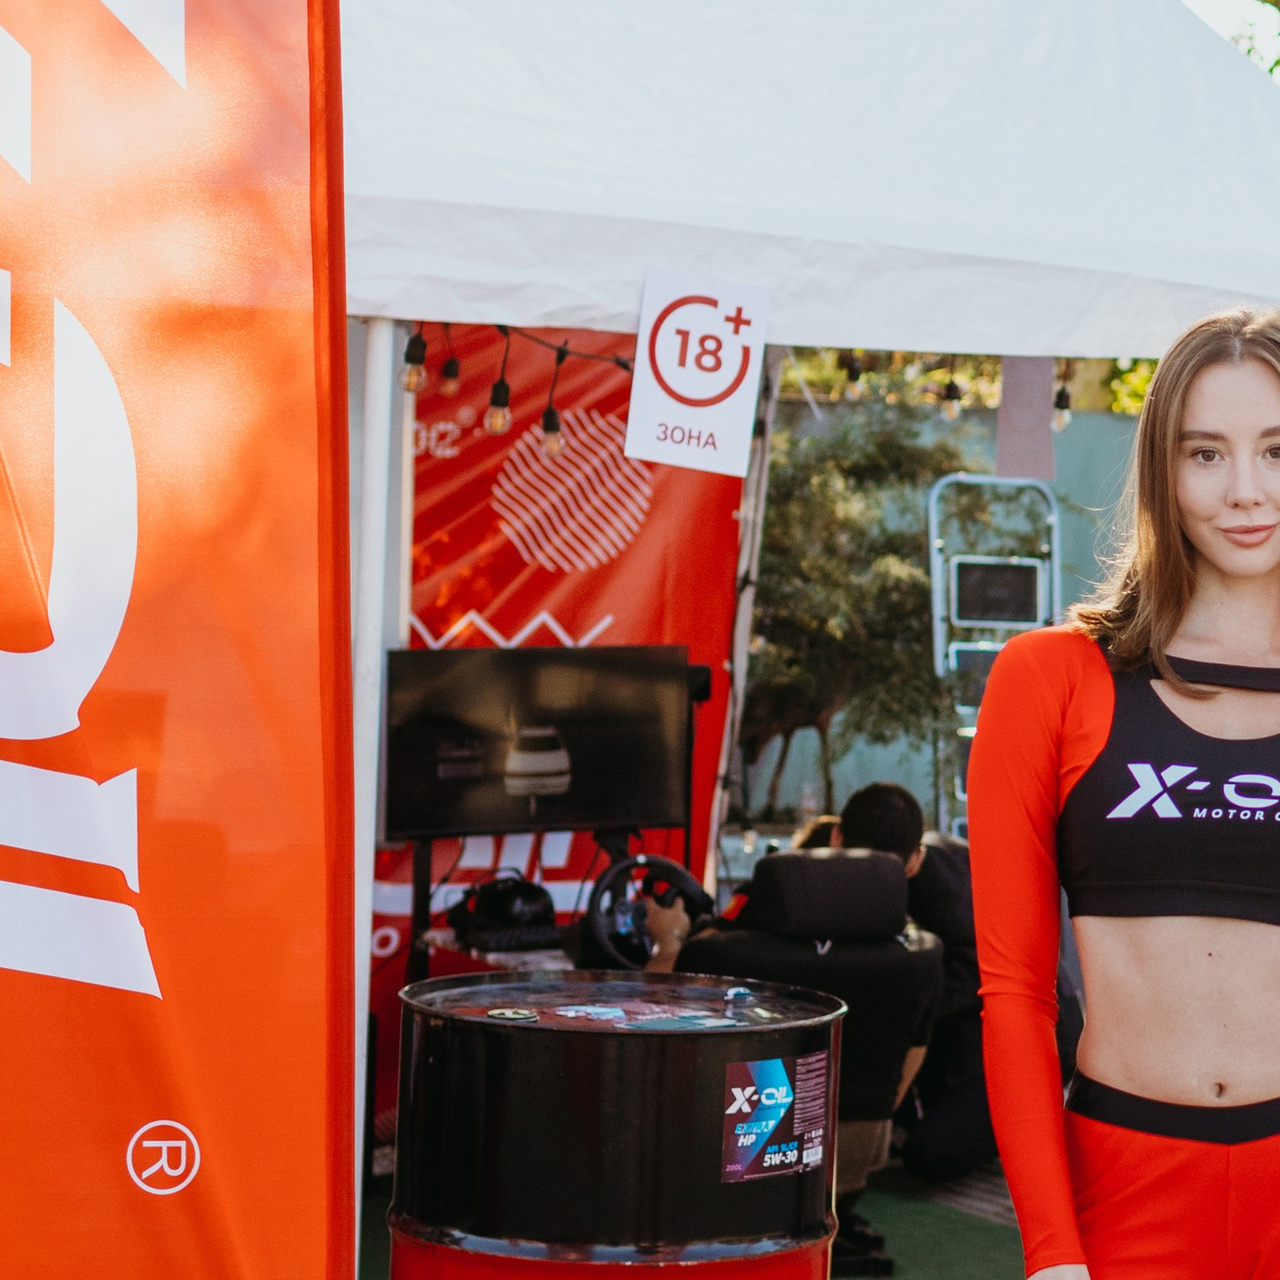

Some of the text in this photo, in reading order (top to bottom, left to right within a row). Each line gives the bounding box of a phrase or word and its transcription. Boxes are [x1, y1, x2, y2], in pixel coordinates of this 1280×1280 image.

[656, 422, 718, 451] ЗОНА
[1193, 807, 1265, 821] MOTOR
[725, 1086, 794, 1115] X-OIL
[737, 1134, 757, 1147] HP
[763, 1150, 799, 1167] 5W-30
